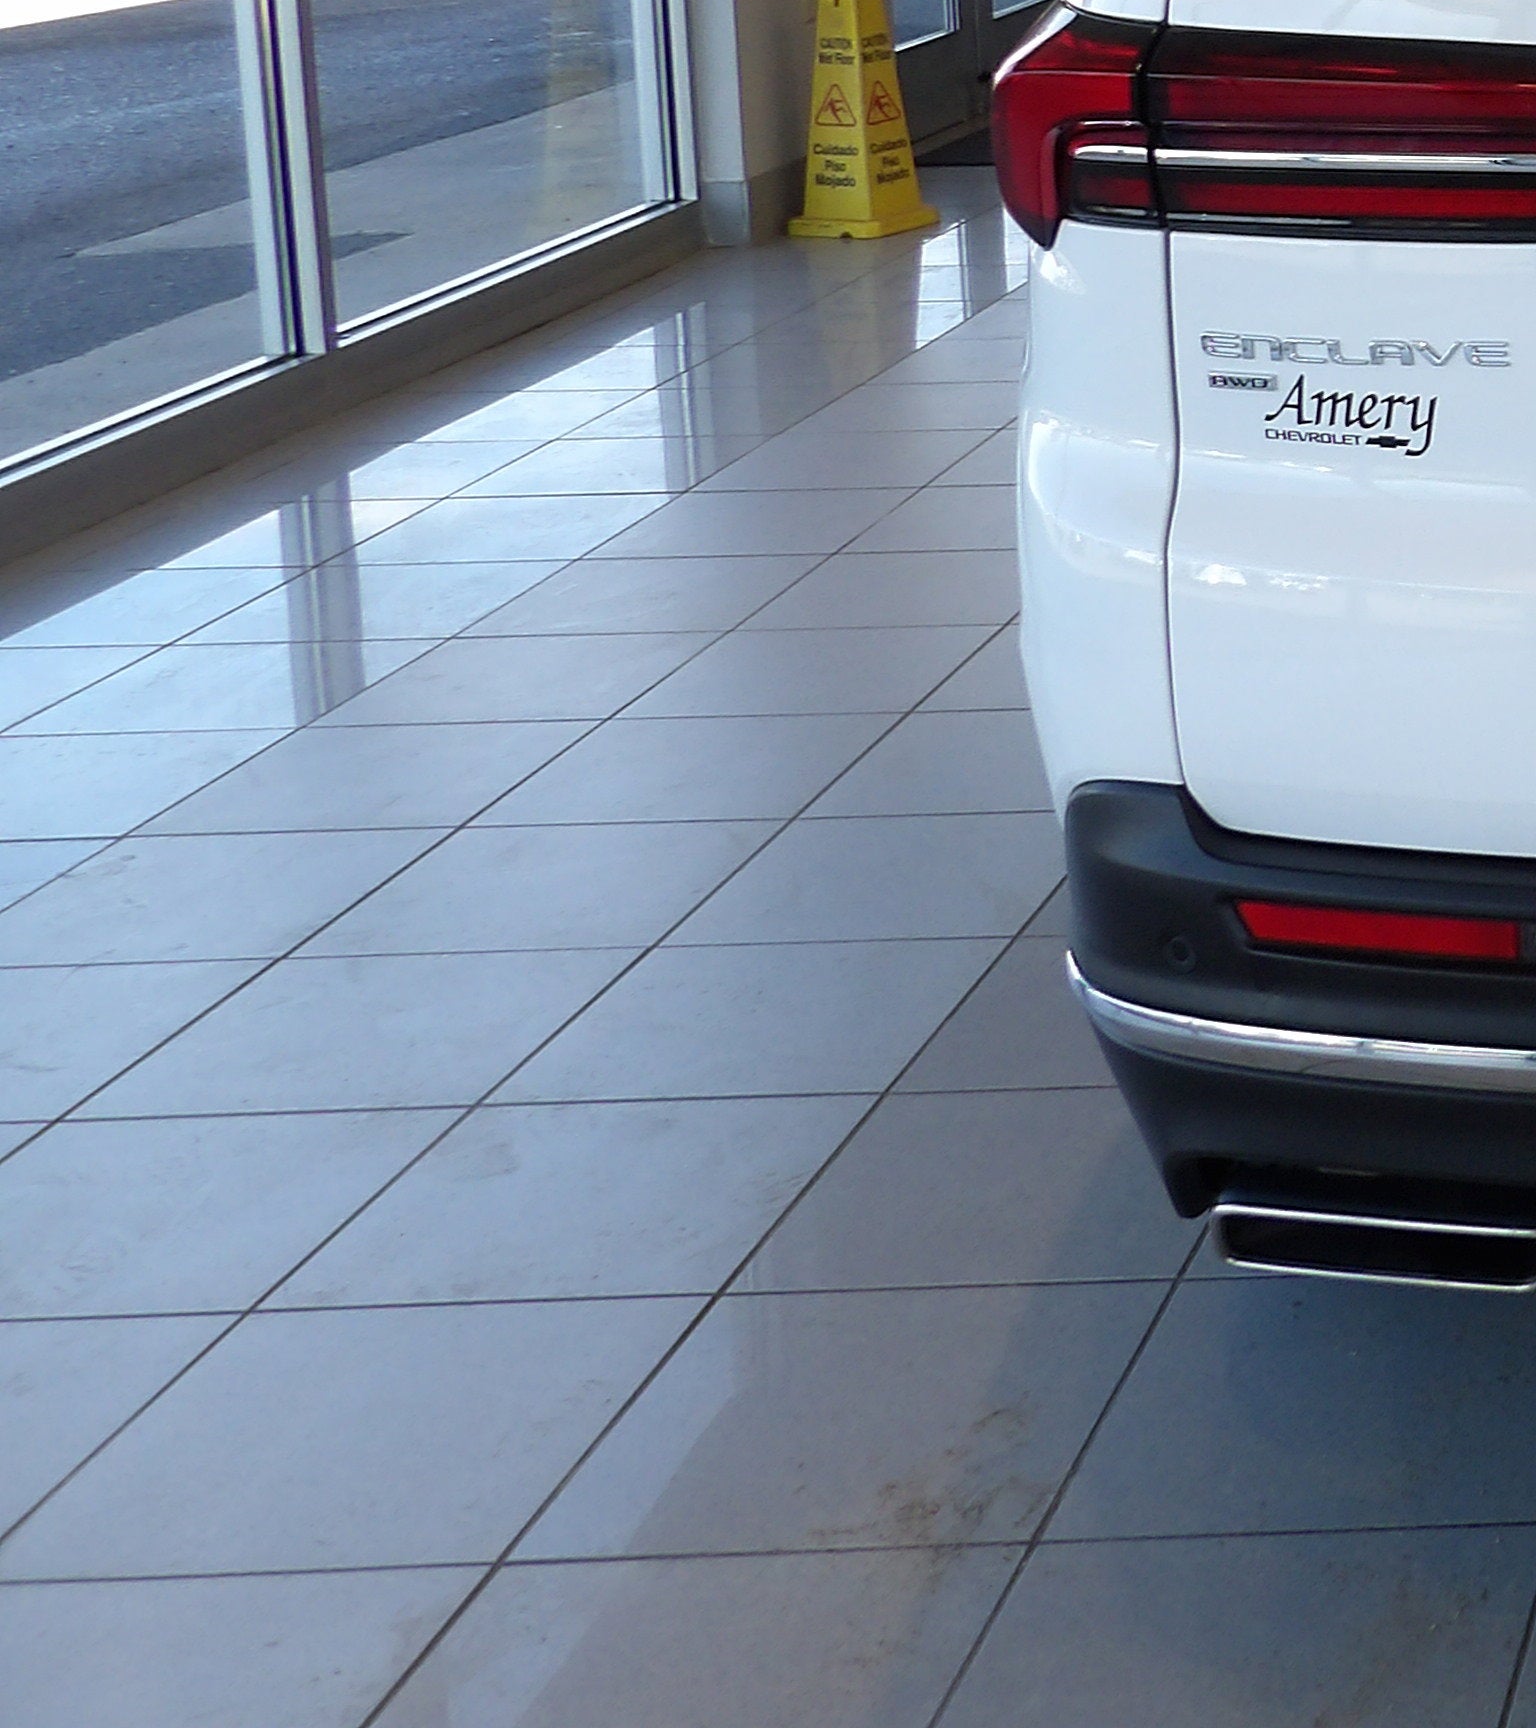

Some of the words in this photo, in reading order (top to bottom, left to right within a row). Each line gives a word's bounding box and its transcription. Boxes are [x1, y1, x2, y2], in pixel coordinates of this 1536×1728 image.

[1199, 330, 1512, 367] ENCLAVE
[1211, 374, 1269, 389] AWD
[1263, 373, 1439, 457] Amery
[1264, 428, 1362, 447] CHEVROLET
